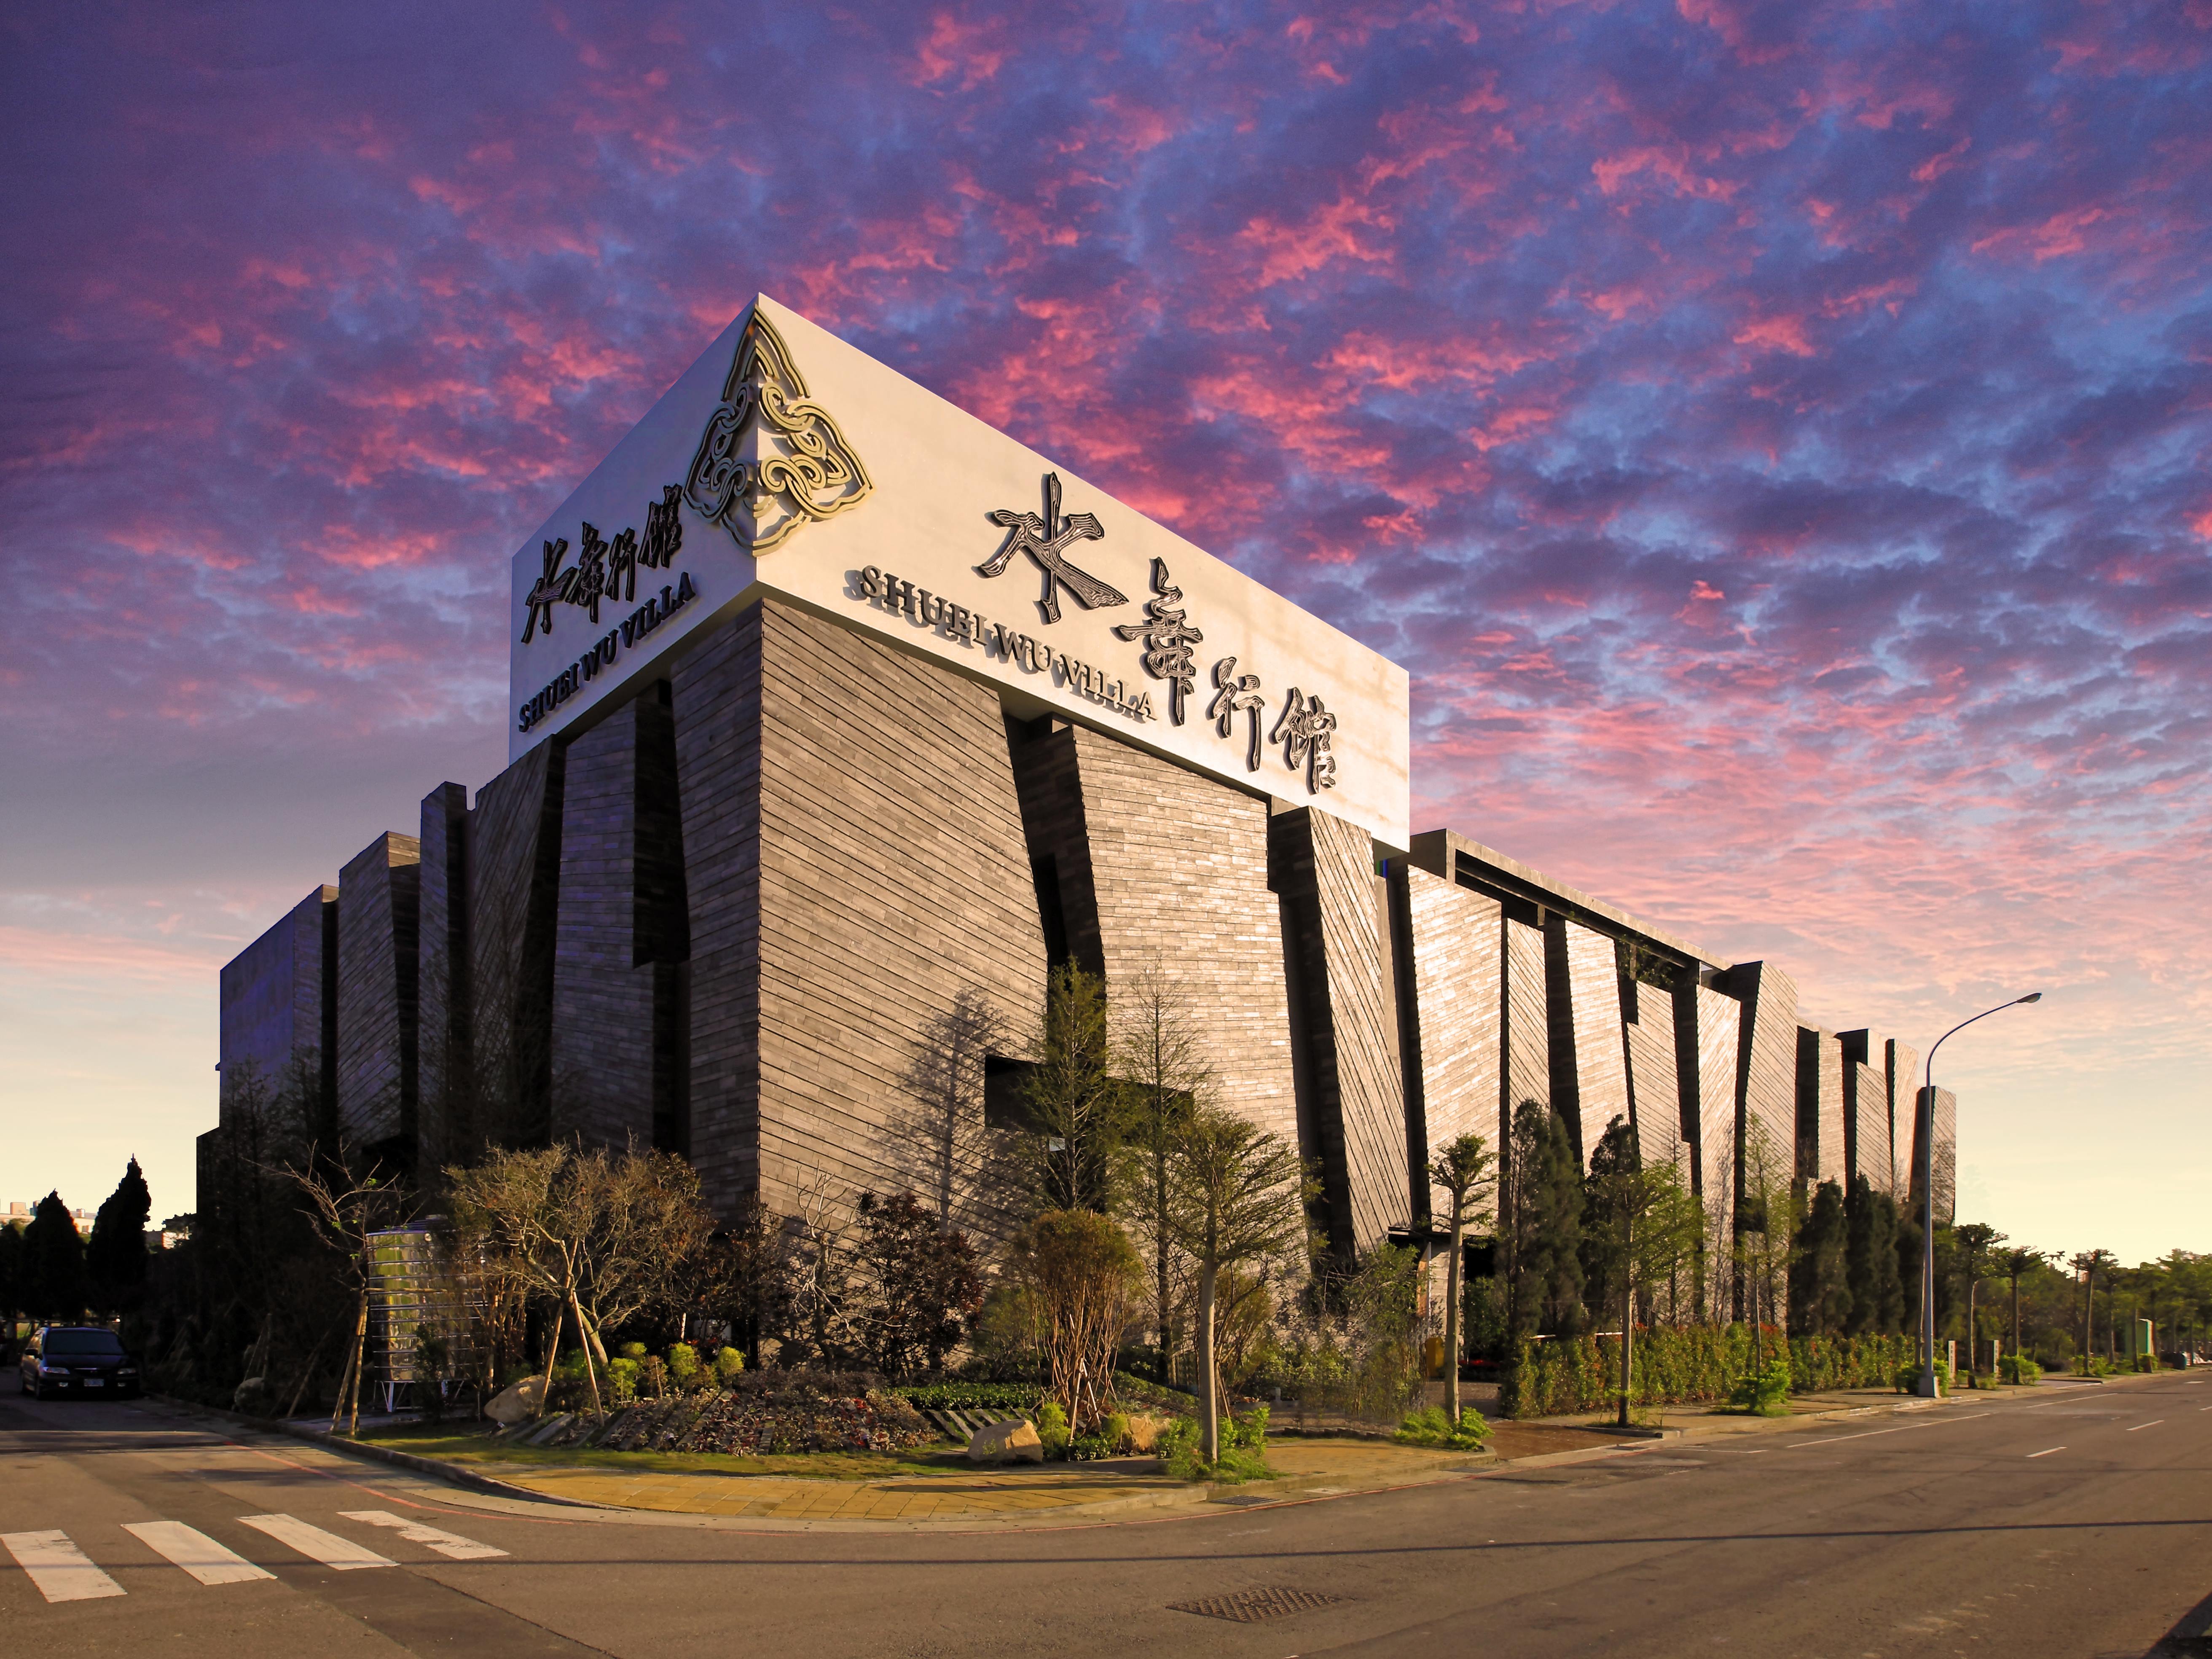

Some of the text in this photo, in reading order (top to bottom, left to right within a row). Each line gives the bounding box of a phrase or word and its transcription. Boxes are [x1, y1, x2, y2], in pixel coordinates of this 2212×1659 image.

[518, 572, 695, 733] SHUEI WU VILLA
[860, 565, 1158, 721] SHUEI WU VILLA
